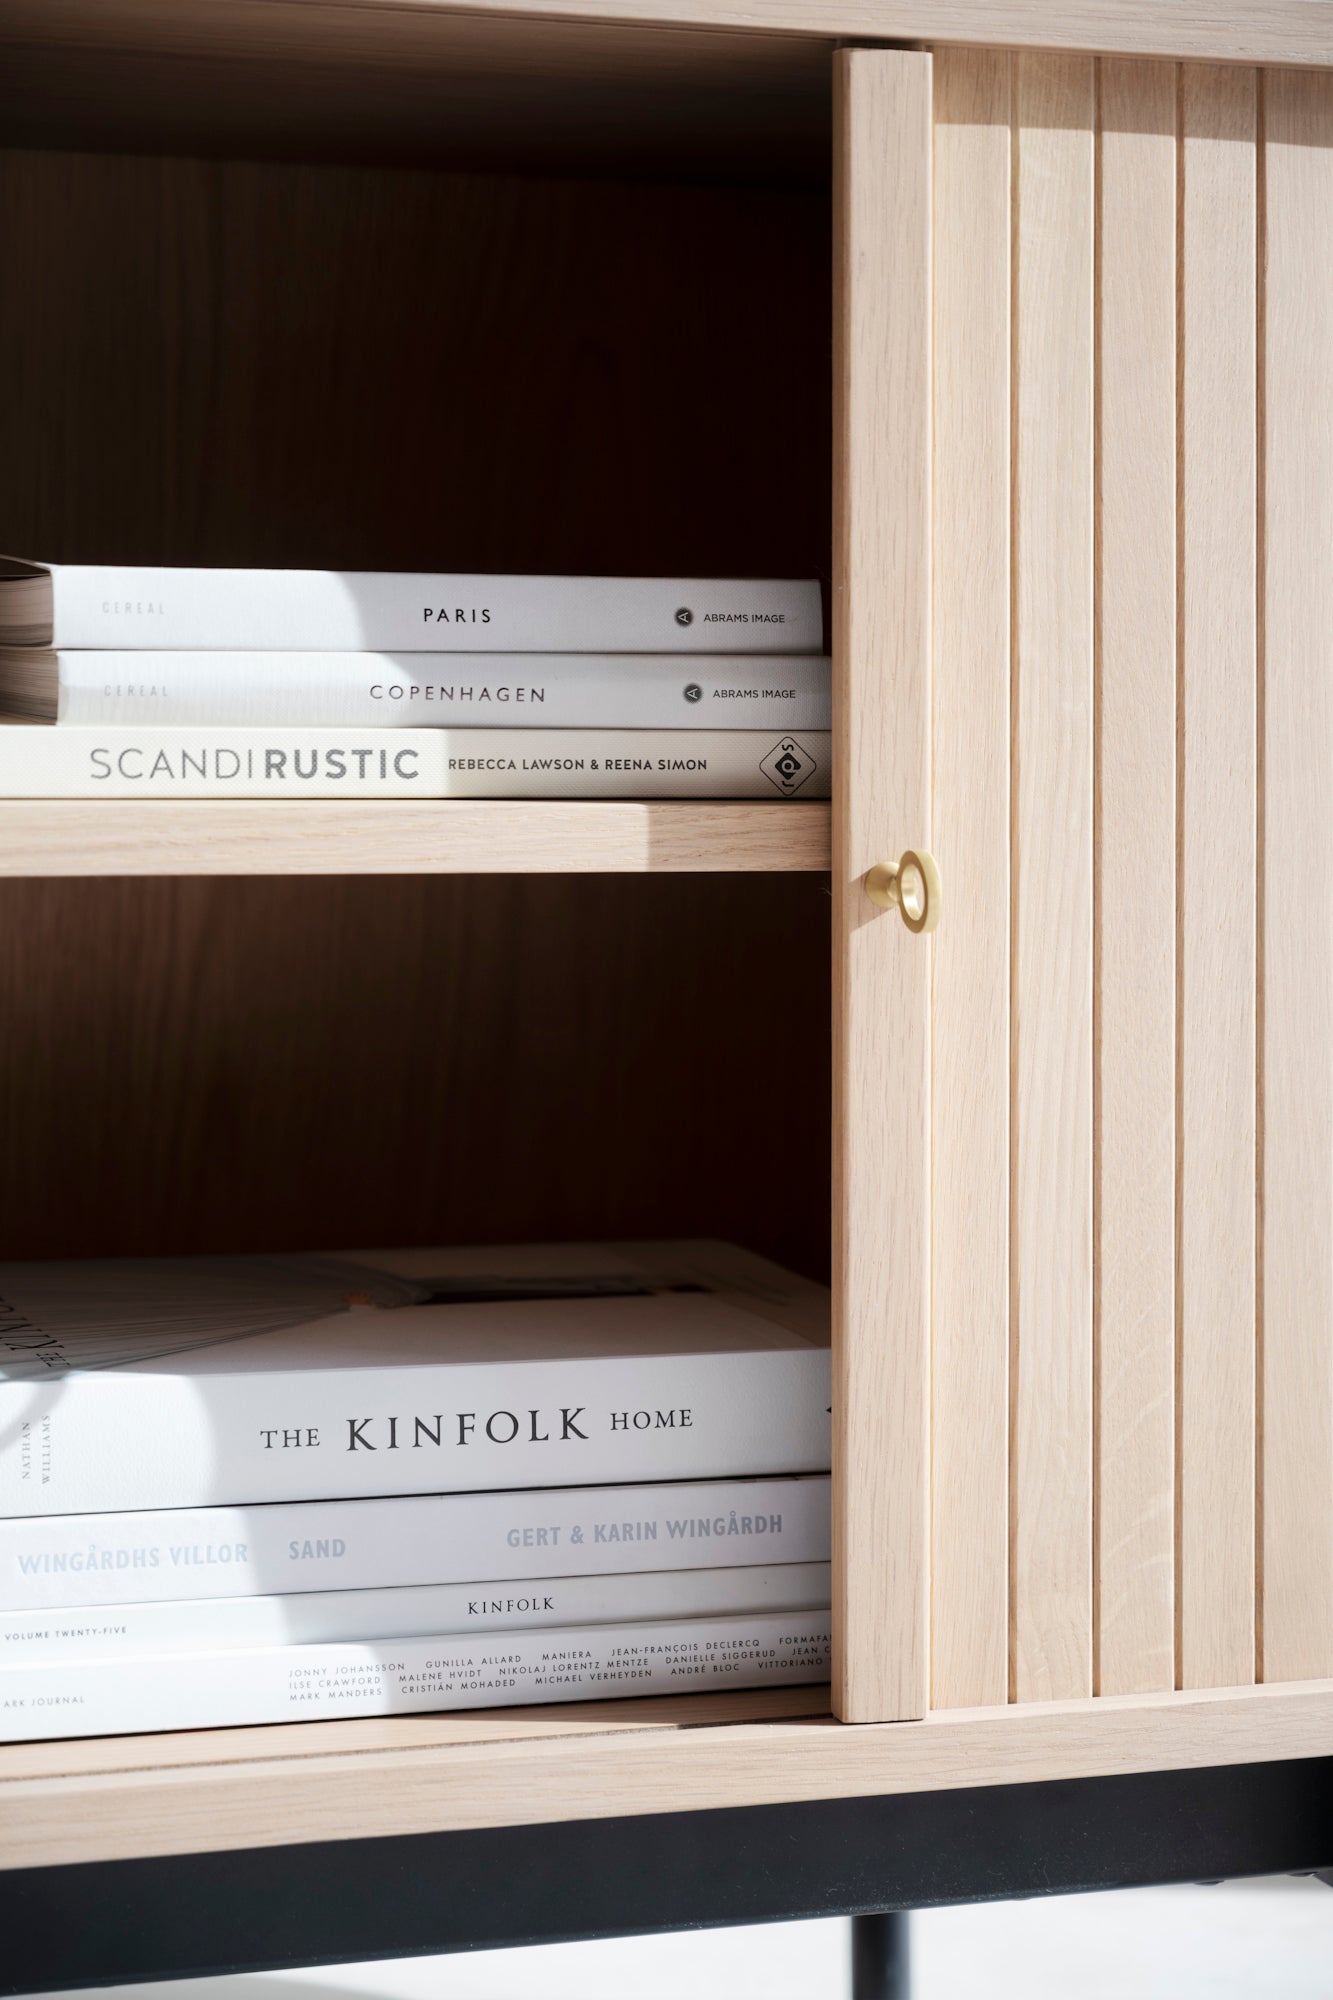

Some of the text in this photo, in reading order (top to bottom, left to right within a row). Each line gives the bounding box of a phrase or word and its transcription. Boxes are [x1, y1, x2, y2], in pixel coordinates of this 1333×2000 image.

[102, 601, 166, 615] CEREAL
[423, 608, 492, 624] PARIS
[703, 613, 786, 623] ABRAMS IMAGE
[104, 684, 169, 698] CEREAL
[369, 684, 546, 703] COPENHAGEN
[713, 689, 796, 699] ABRAMS IMAGE
[448, 758, 708, 771] REBECCA LAWSON & REENA SIMON
[260, 1407, 694, 1452] THE KINFOLK HOME
[22, 1422, 31, 1480] NATHAN
[42, 1415, 51, 1484] WILLIAMS
[17, 1511, 783, 1575] WINGÅRDHS VILLOR SAND GERT & KARIN WINGÅRDH
[5, 1597, 555, 1641] VOLUME TWENTY-FIVE KINFOLK
[289, 1668, 327, 1678] JONNY
[335, 1663, 405, 1675] JOHANSSON
[425, 1659, 473, 1669] GUNILLA
[481, 1656, 521, 1665] ALLARD
[542, 1651, 591, 1661] MANIERA
[611, 1643, 698, 1656] JEAN-FRANÇOIS
[706, 1639, 760, 1650] DECLERCQ
[289, 1680, 311, 1689] ILSE
[318, 1676, 381, 1688] CRAWFORD
[399, 1672, 443, 1682] MALENE
[449, 1669, 482, 1679] HVIDT
[499, 1665, 546, 1676] NIKOLAJ
[553, 1661, 600, 1672] LORENTZ
[607, 1658, 649, 1668] MENTZE
[666, 1653, 716, 1664] DANIELLE
[722, 1650, 776, 1661] SIGGERUD
[792, 1643, 818, 1656] JEAN
[289, 1692, 320, 1701] MARK
[328, 1688, 382, 1699] MANDERS
[401, 1682, 453, 1694] CRISTIÁN
[461, 1679, 516, 1690] MOHADED
[535, 1674, 583, 1685] MICHAEL
[590, 1669, 652, 1681] VERHEYDEN
[671, 1665, 706, 1675] ANDRÉ
[713, 1663, 740, 1672] BLOC
[758, 1657, 823, 1669] VITTORIANO
[31, 1696, 85, 1706] JOURNAL
